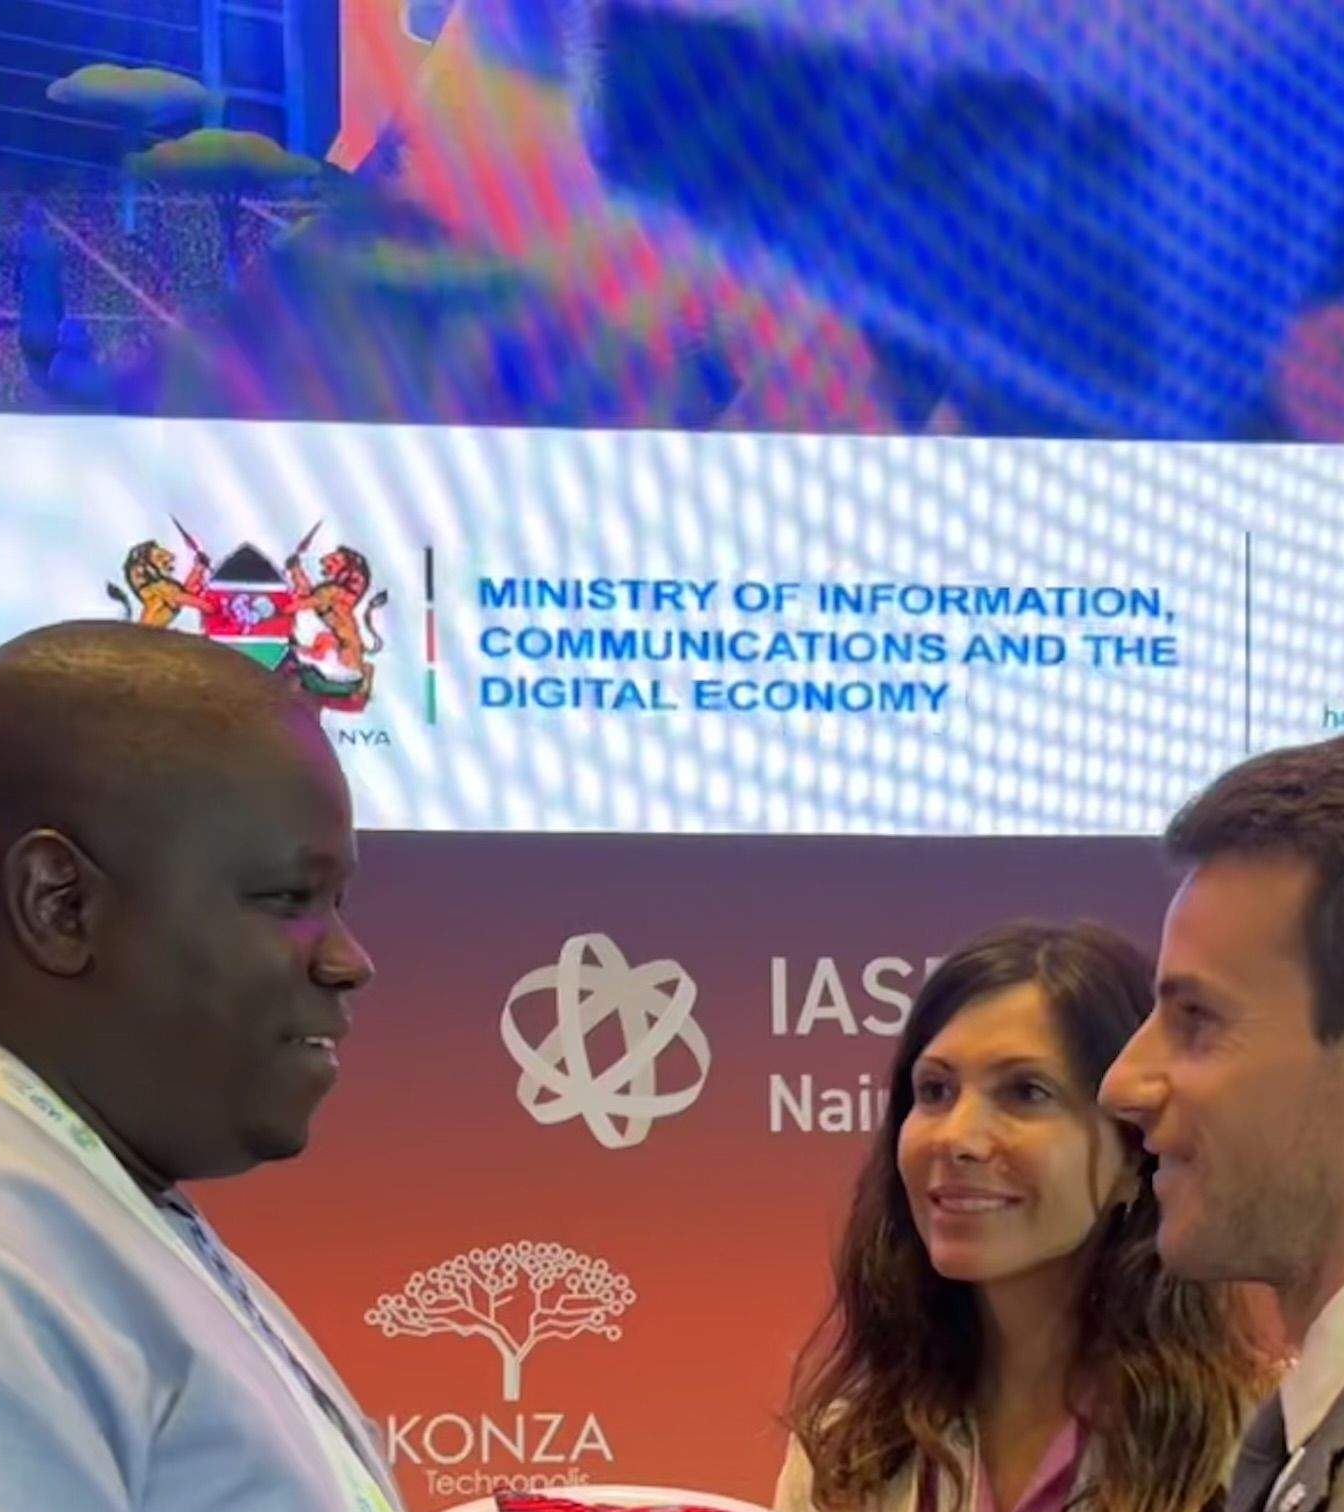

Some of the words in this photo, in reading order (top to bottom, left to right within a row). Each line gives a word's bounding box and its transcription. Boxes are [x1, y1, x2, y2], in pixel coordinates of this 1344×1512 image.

[478, 577, 718, 611] MINISTRY
[733, 581, 801, 613] OF
[819, 583, 1176, 623] INFORMATION,
[479, 626, 947, 663] COMMUNICATIONS
[962, 633, 1067, 666] AND
[1082, 634, 1179, 667] THE
[480, 676, 679, 709] DIGITAL
[693, 680, 950, 713] ECONOMY
[387, 1412, 614, 1465] KONZA
